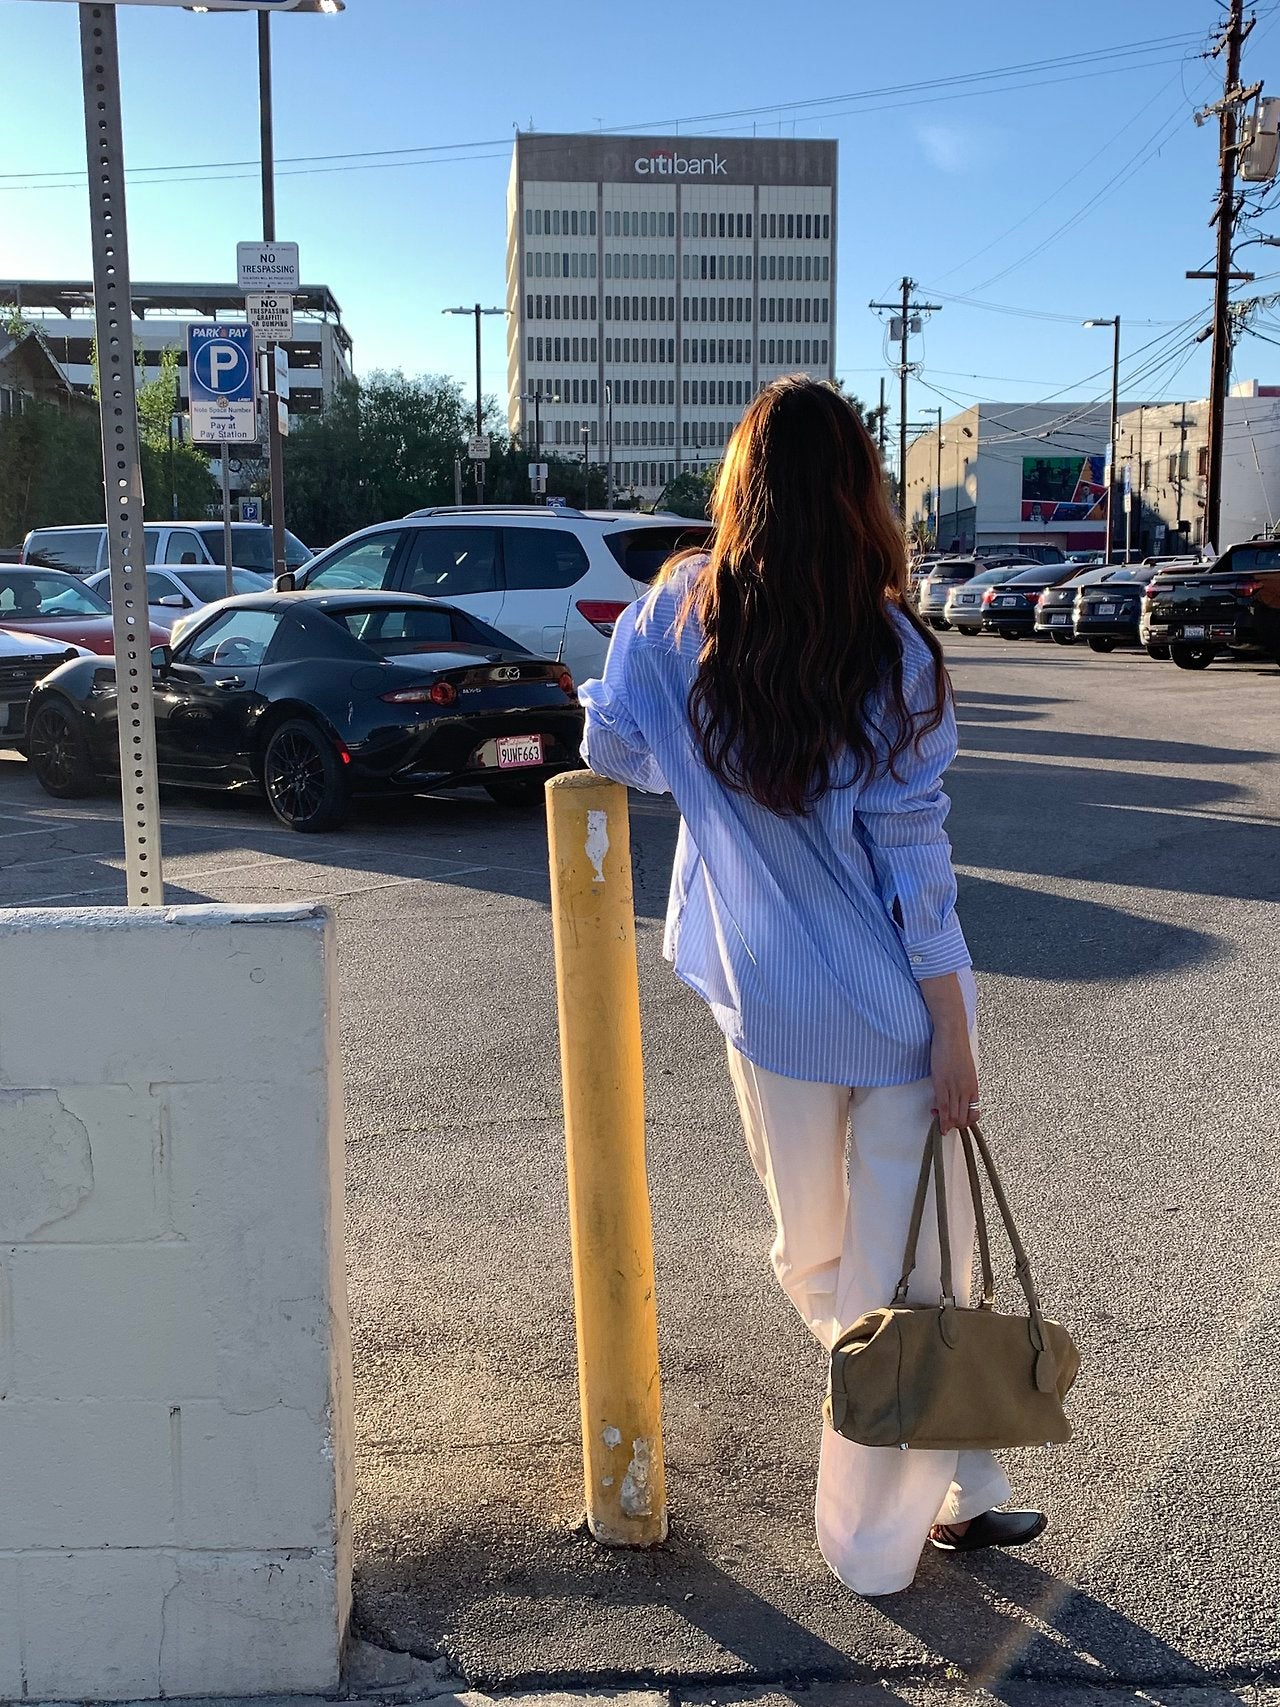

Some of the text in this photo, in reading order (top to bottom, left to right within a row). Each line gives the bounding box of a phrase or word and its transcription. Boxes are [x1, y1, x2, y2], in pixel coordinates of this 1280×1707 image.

[634, 152, 728, 175] citibank
[260, 253, 276, 263] NO
[242, 265, 295, 273] TRESPASSING
[260, 300, 277, 308] NO
[192, 328, 220, 338] PARK
[228, 328, 248, 338] PAY
[209, 345, 238, 389] P
[210, 421, 226, 430] Pay
[200, 430, 248, 439] Pay Station
[501, 746, 540, 763] 9UWF663
